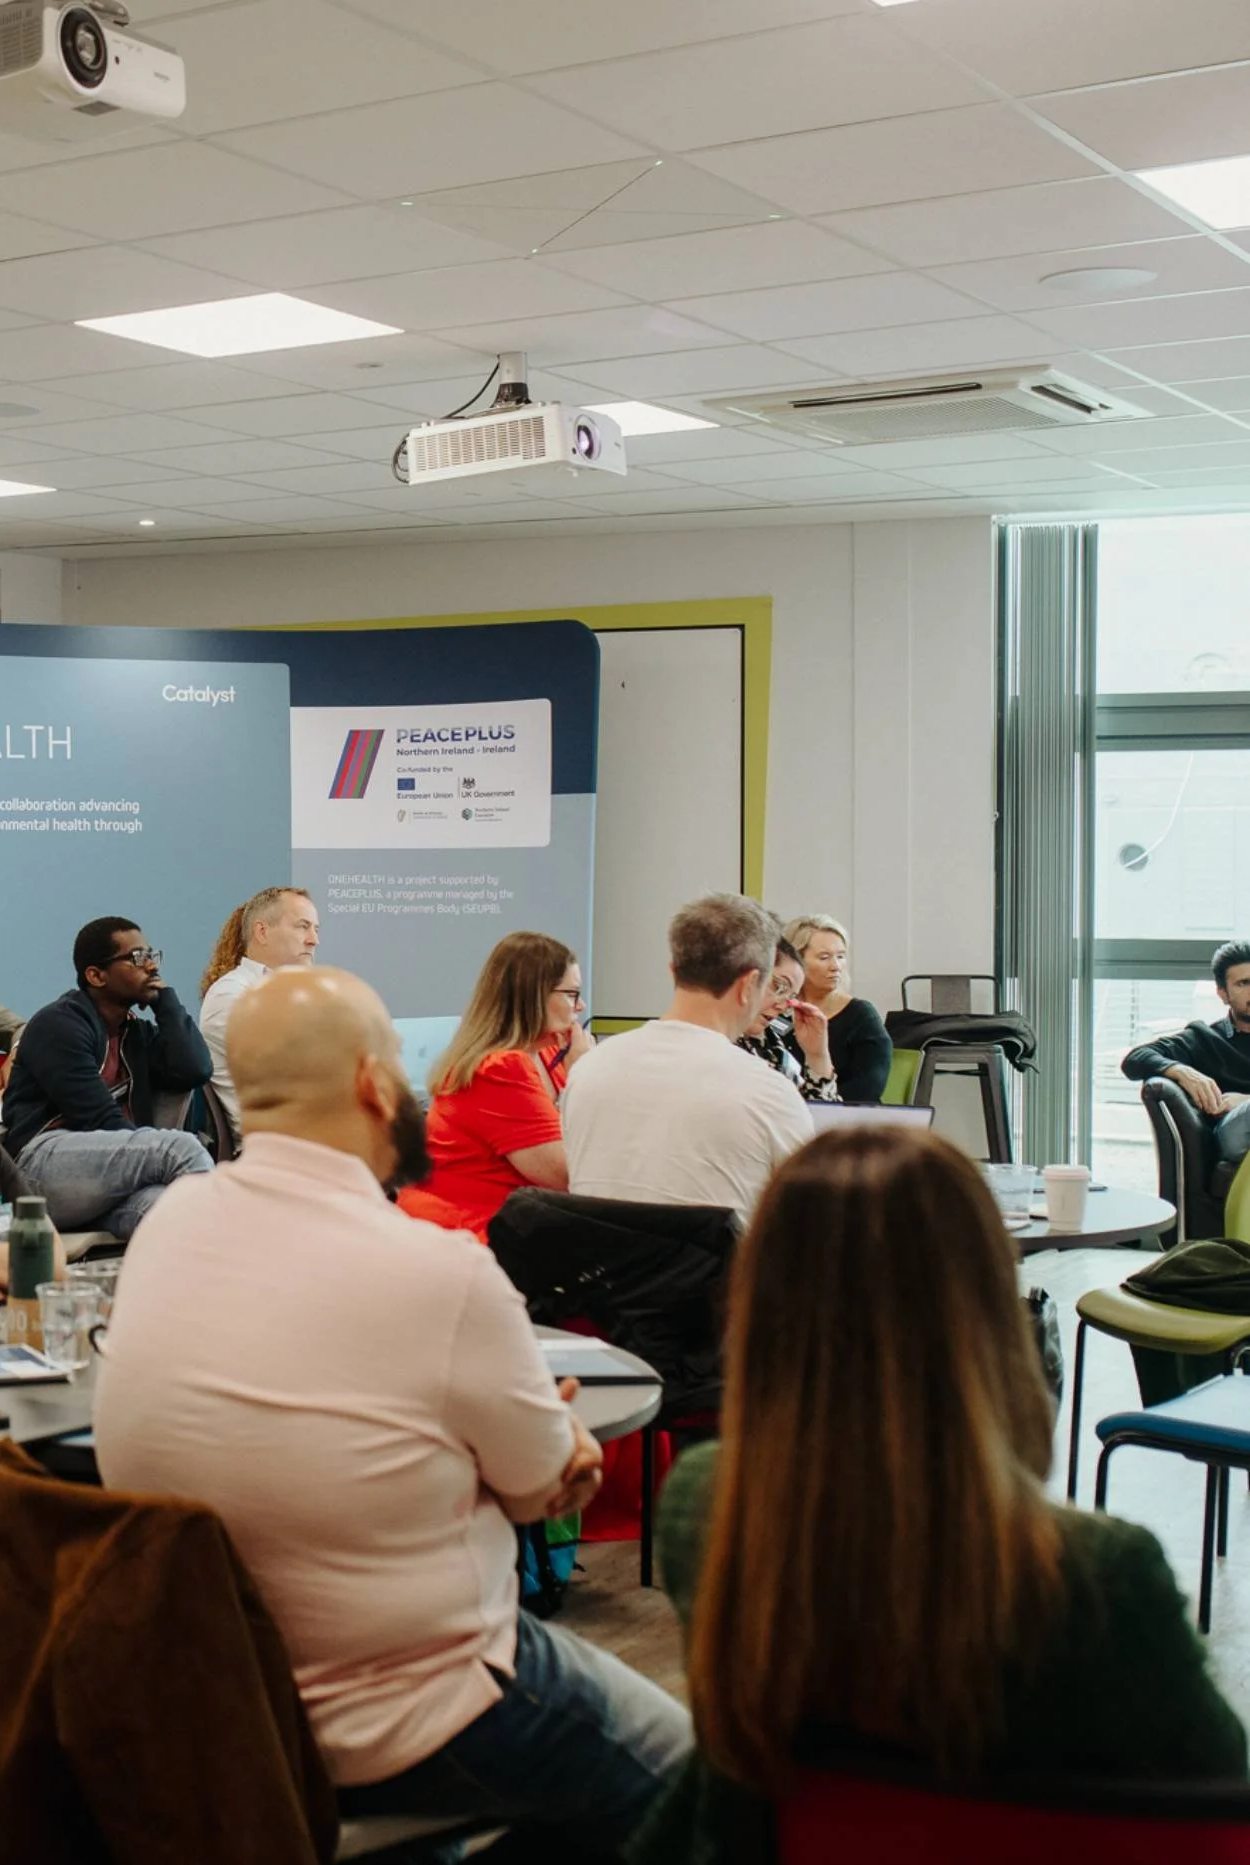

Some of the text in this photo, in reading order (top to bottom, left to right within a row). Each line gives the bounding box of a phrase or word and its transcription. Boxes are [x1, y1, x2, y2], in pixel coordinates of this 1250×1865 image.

[162, 684, 236, 706] Catalyst
[396, 724, 515, 743] PEACEPLUS
[396, 747, 439, 756] Northern
[441, 746, 475, 756] Ireland
[482, 744, 516, 754] Ireland
[432, 766, 441, 774] by
[432, 791, 454, 799] Union
[461, 790, 515, 799] UK Government
[0, 798, 77, 812] collaboration
[78, 798, 141, 814] advancing
[52, 818, 91, 832] health
[93, 818, 143, 834] through
[327, 874, 499, 887] ONEHEALTH is a project supported by
[386, 891, 392, 899] a
[393, 890, 444, 901] programme
[445, 889, 485, 901] managed
[486, 889, 498, 901] by
[499, 889, 514, 900] the
[327, 903, 360, 915] Special
[361, 903, 375, 914] EU
[377, 903, 435, 915] Programmes
[436, 903, 460, 915] Body
